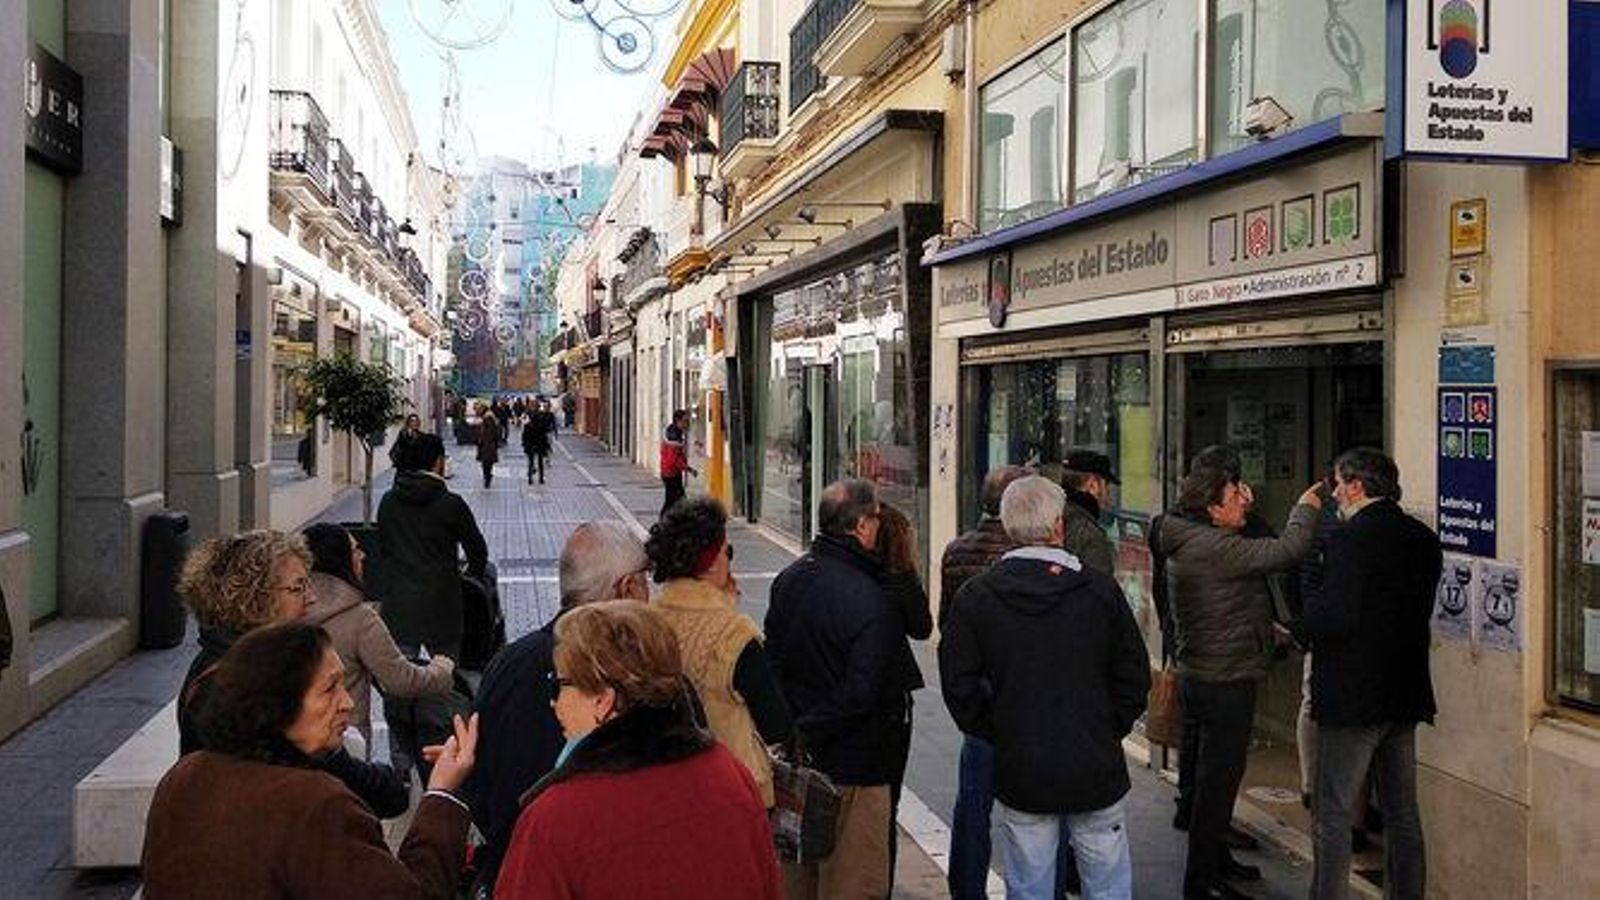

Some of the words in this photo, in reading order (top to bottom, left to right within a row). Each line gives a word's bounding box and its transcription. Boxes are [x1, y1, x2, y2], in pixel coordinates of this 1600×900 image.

[1427, 81, 1494, 100] Loterías
[1498, 88, 1508, 105] y
[1428, 103, 1504, 122] Apuestas
[1508, 107, 1533, 123] del
[1427, 124, 1485, 141] Estado
[1013, 258, 1074, 298] Apuestas
[1078, 243, 1101, 281] del
[1106, 230, 1169, 275] Estado
[1356, 262, 1365, 280] 2
